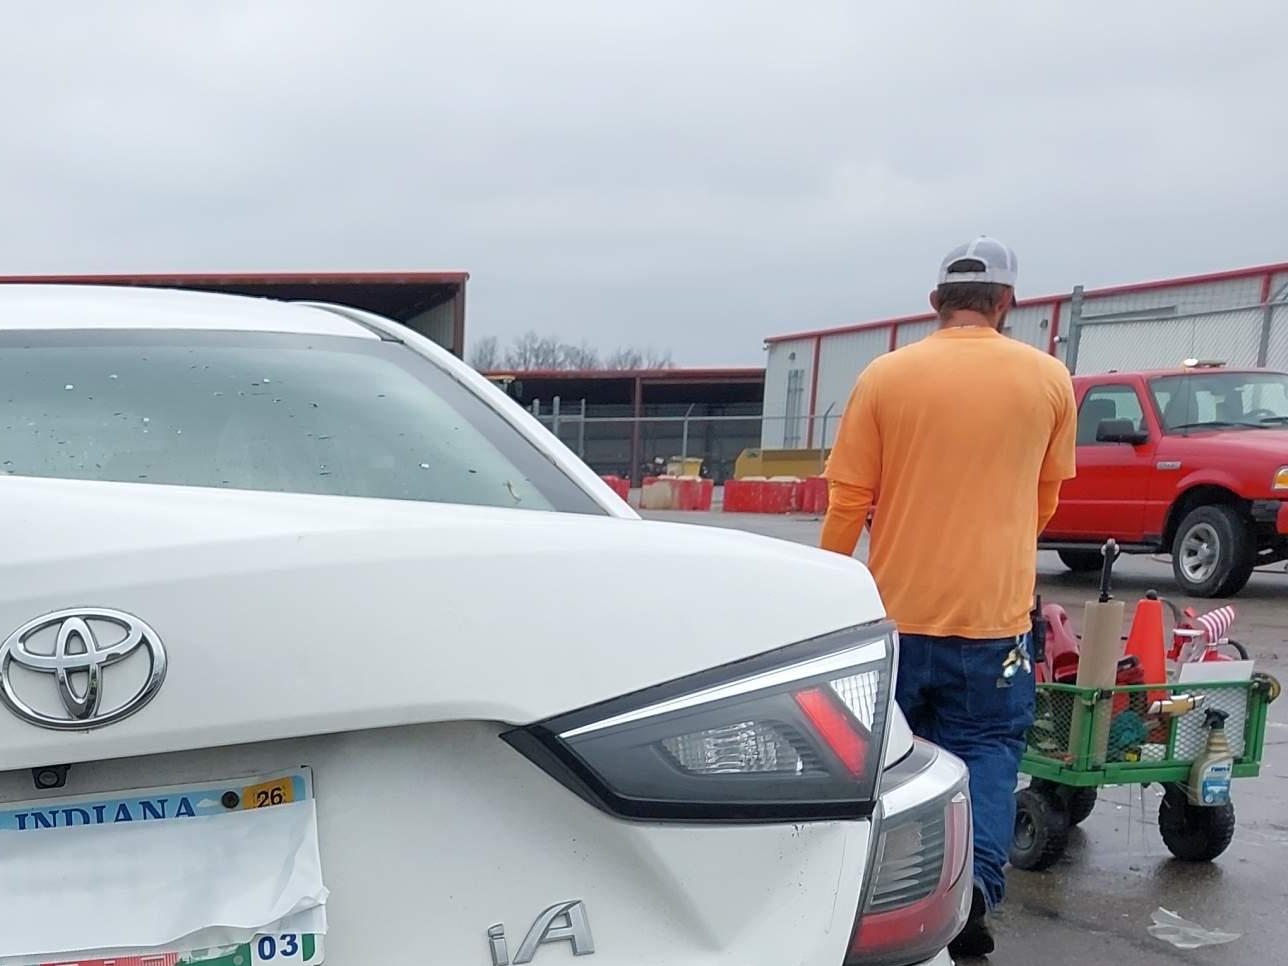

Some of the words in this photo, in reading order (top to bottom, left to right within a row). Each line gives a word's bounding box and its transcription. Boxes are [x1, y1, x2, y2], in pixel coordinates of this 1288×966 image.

[256, 787, 283, 808] 26
[14, 797, 196, 831] INDIANA
[257, 933, 299, 961] 03
[487, 899, 595, 966] iA
